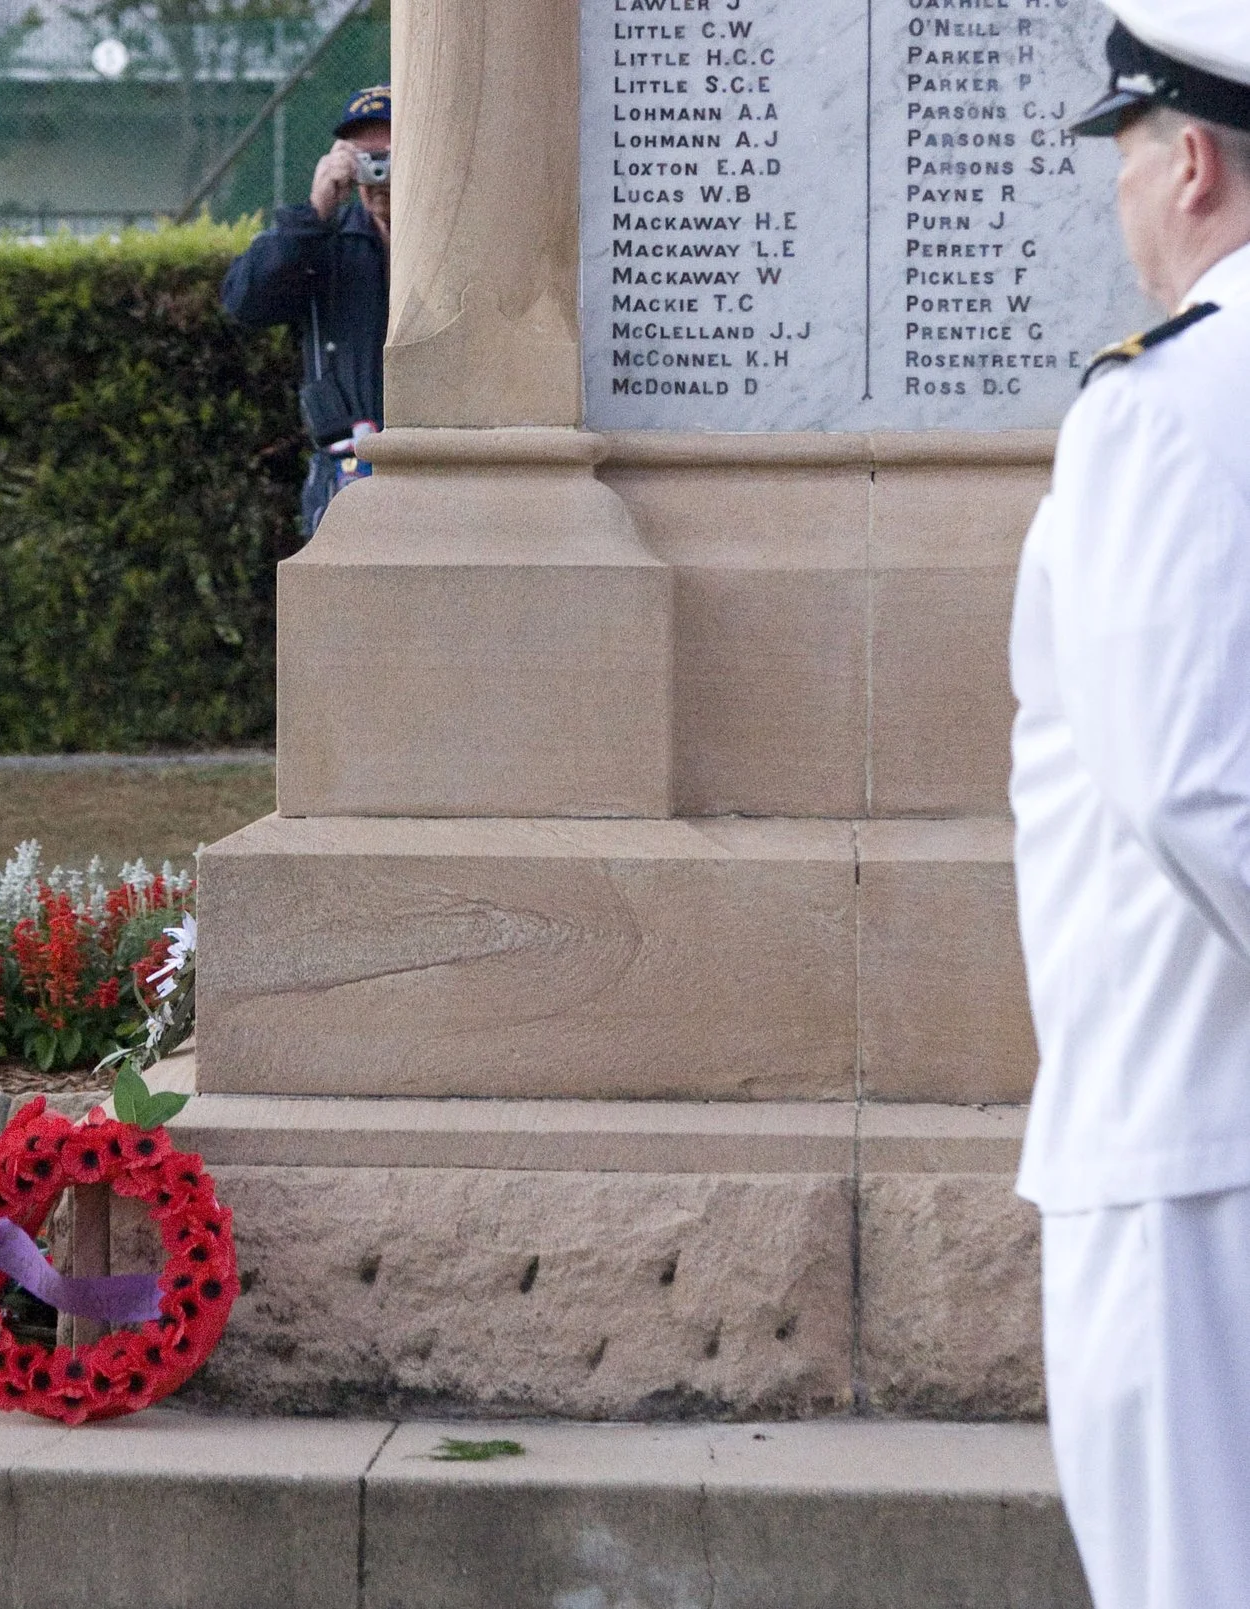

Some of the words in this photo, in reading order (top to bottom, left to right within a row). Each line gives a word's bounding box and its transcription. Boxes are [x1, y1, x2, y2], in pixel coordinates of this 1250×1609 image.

[614, 0, 711, 12] LAWLER
[725, 0, 741, 12] J
[614, 22, 686, 40] LITTLE
[700, 20, 753, 39] C.W
[908, 17, 1000, 37] O'NEILL
[1017, 18, 1032, 36] R
[614, 49, 690, 67] LITTLE
[907, 46, 1000, 64] PARKER
[1018, 45, 1034, 64] H
[614, 76, 688, 94] LITTLE
[704, 75, 771, 94] S.C.E
[907, 73, 999, 92] PARKER
[1018, 73, 1032, 91] P
[614, 104, 722, 122] LOHMANN
[737, 103, 778, 121] A.A
[907, 102, 1007, 120] PARSONS
[1023, 101, 1066, 120] C.J
[614, 131, 721, 148] LOHMANN
[735, 130, 779, 148] A.J
[907, 129, 1016, 148] PARSONS
[613, 159, 699, 177] LOXTON
[716, 158, 782, 176] E.A.D
[907, 156, 1014, 176] PARSONS
[1029, 156, 1076, 175] S.A
[613, 185, 685, 203] LUCAS
[700, 185, 752, 203] W.B
[907, 184, 984, 203] PAYNE
[1001, 184, 1016, 202] R
[612, 213, 742, 231] MACKAWAY
[754, 212, 798, 230] H.E
[907, 212, 970, 230] PURN
[988, 211, 1005, 230] J
[612, 239, 741, 258] MACKAWAY
[756, 239, 796, 258] L.E
[906, 239, 1004, 258] PERRETT
[612, 267, 741, 285] MACKAWAY
[756, 267, 783, 285] W
[906, 267, 995, 285] PICKLES
[1014, 267, 1028, 286] F
[612, 294, 699, 312] MACKIE
[713, 294, 754, 312] T.C
[906, 295, 992, 313] PORTER
[1007, 294, 1033, 313] W
[769, 321, 811, 340] J.J
[906, 322, 1012, 341] PRENTICE
[746, 349, 789, 367] K.H
[905, 350, 1057, 368] ROSENTRETER
[744, 377, 759, 395] D
[905, 377, 967, 395] ROSS
[983, 377, 1022, 395] D.C
